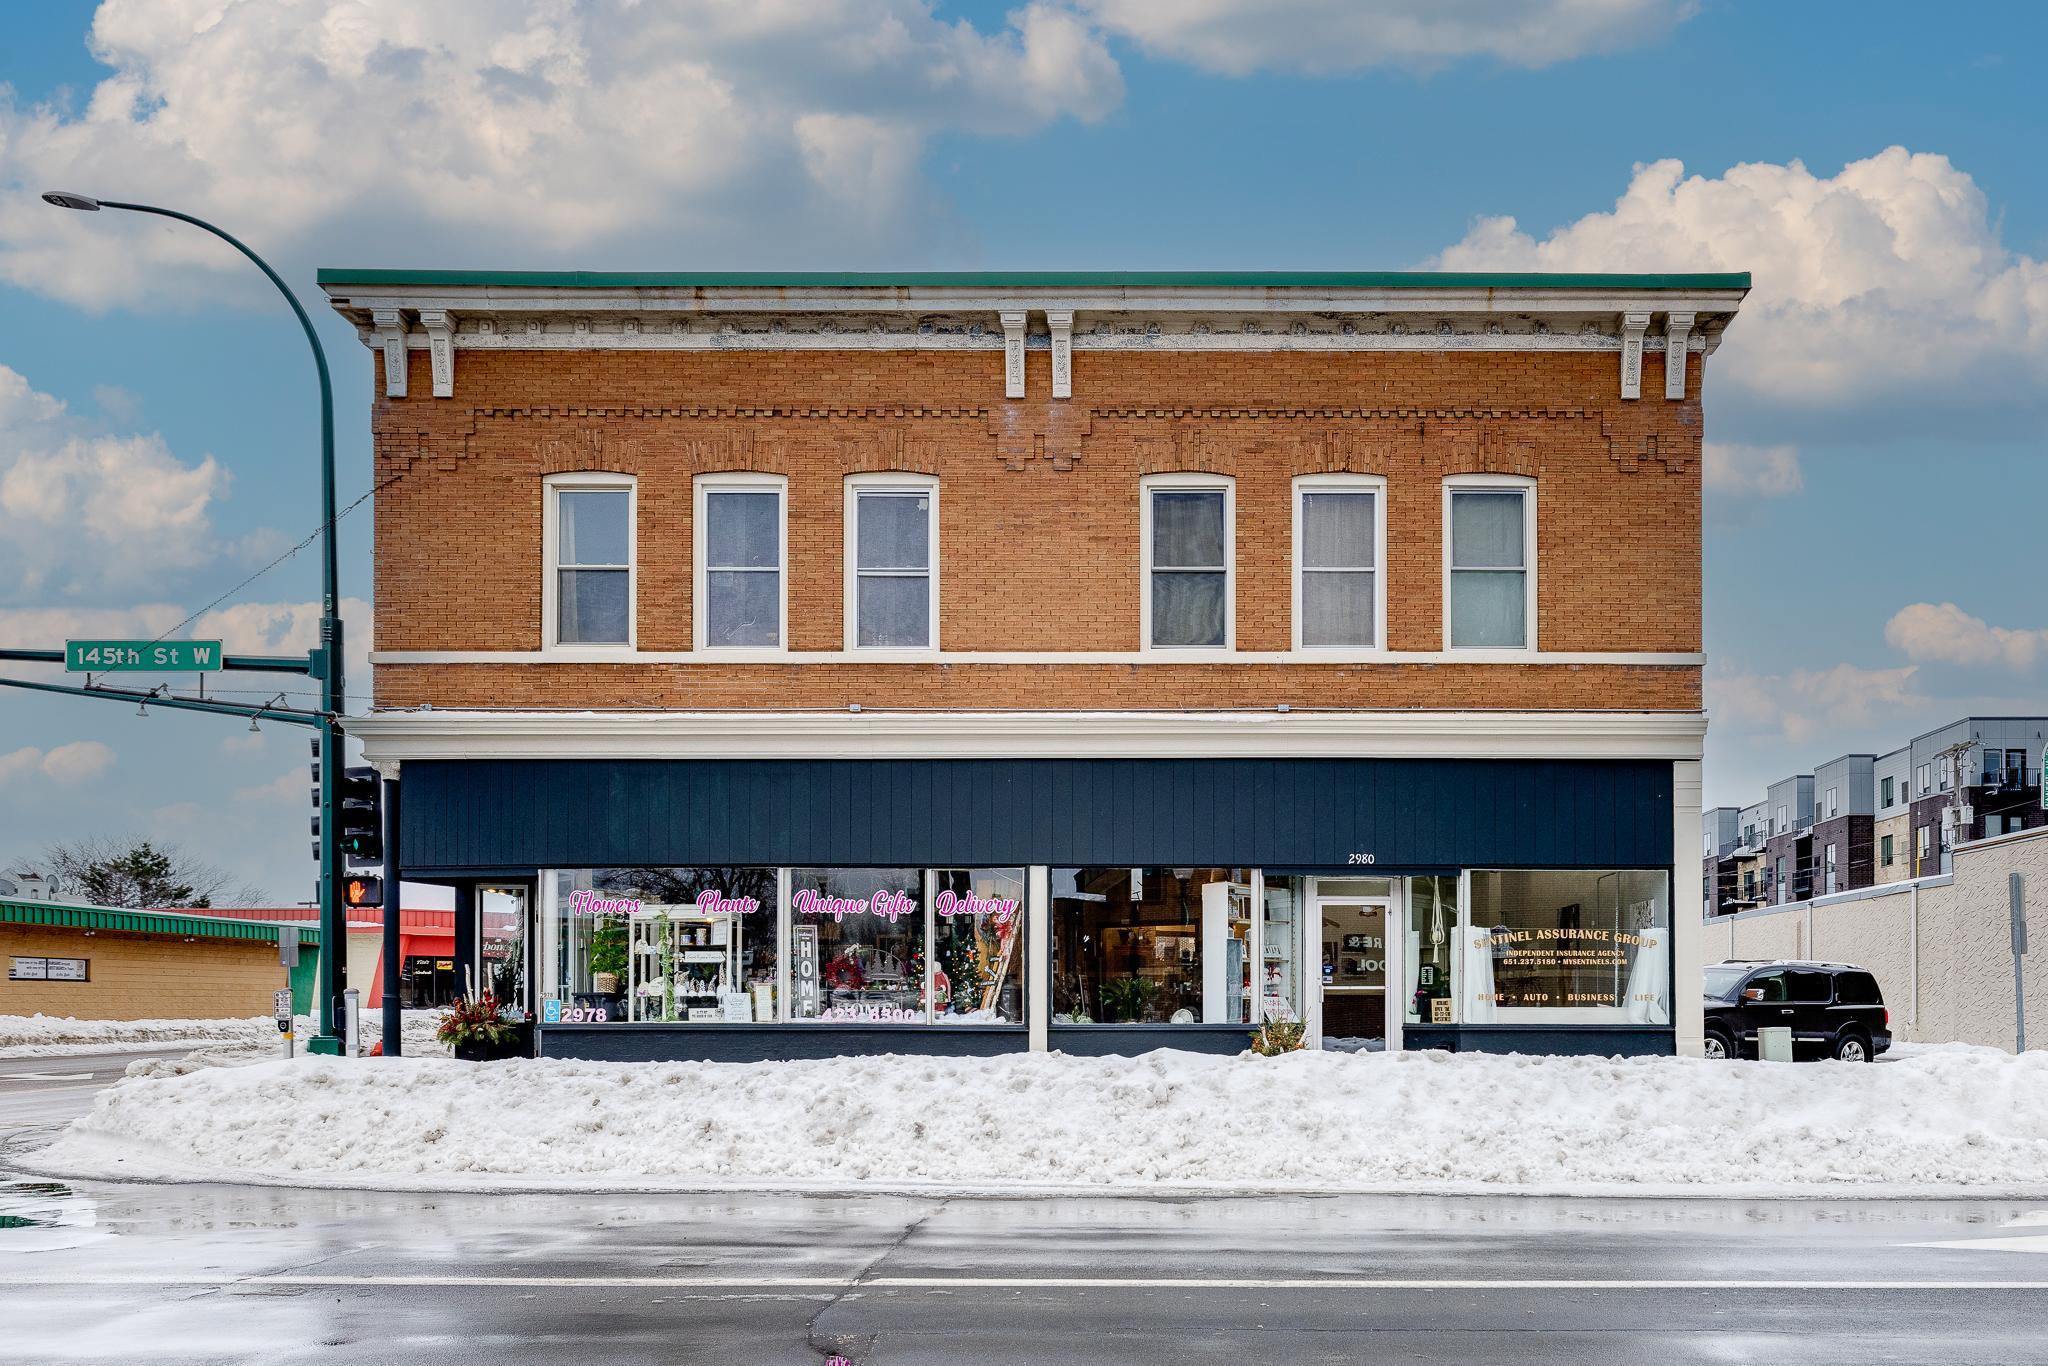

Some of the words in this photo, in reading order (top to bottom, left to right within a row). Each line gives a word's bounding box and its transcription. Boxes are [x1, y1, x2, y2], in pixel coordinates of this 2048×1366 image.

[77, 647, 140, 665] 145th
[154, 647, 179, 665] St
[193, 647, 211, 665] W
[1348, 853, 1375, 865] 2980
[569, 890, 645, 916] Flowers
[696, 890, 760, 915] Plants
[793, 889, 869, 923] Unique
[871, 890, 918, 923] Gifts
[936, 890, 1021, 922] Delivery
[1473, 930, 1533, 950] SENTINEL
[1536, 928, 1610, 941] ASSURANCE
[1613, 932, 1657, 949] GROUP
[1477, 993, 1505, 1001] HOME
[1523, 993, 1549, 1001] AUTO
[1567, 993, 1615, 1001] BUSINESS
[1634, 993, 1656, 1001] LIFE
[561, 1008, 607, 1022] 2978
